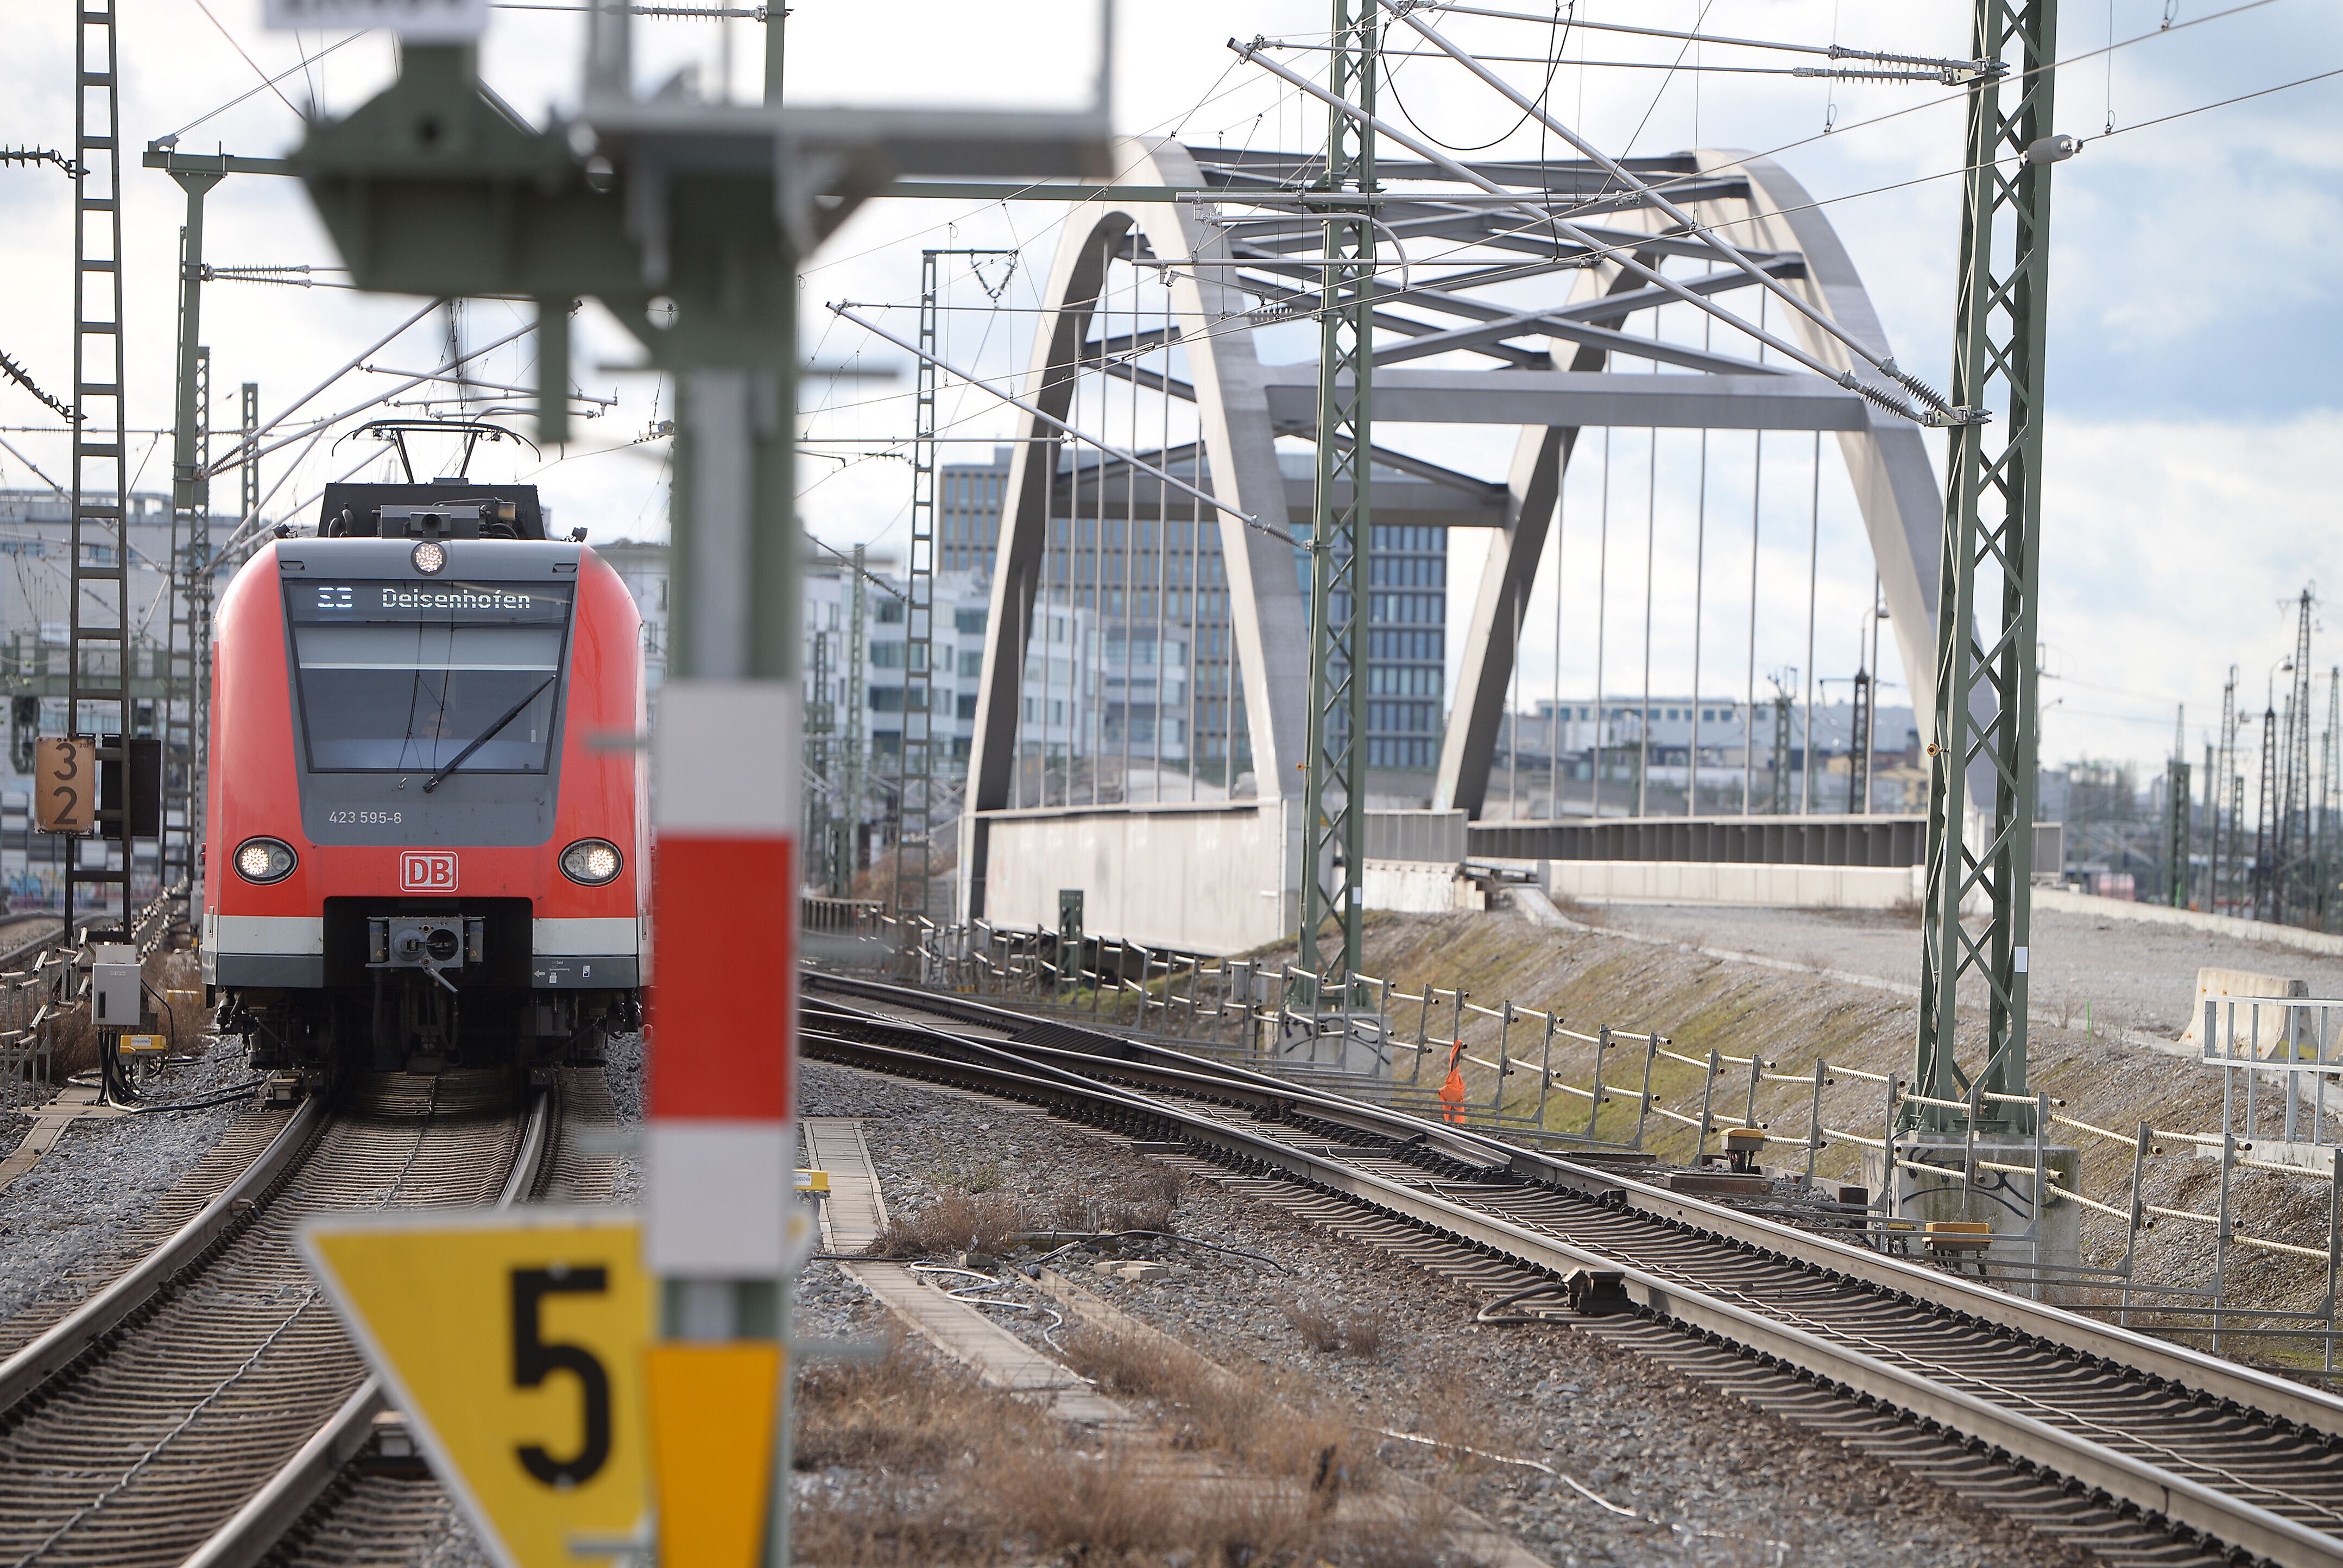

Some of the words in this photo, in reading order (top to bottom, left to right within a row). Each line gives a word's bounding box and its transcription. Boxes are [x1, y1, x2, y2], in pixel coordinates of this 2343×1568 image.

[318, 587, 353, 608] S3
[382, 588, 531, 609] Deisenhofen
[54, 742, 77, 780] 3
[53, 786, 77, 824] 2
[329, 811, 356, 823] 423
[360, 812, 402, 824] 595-8
[409, 859, 450, 884] DB
[510, 1266, 612, 1492] 5
